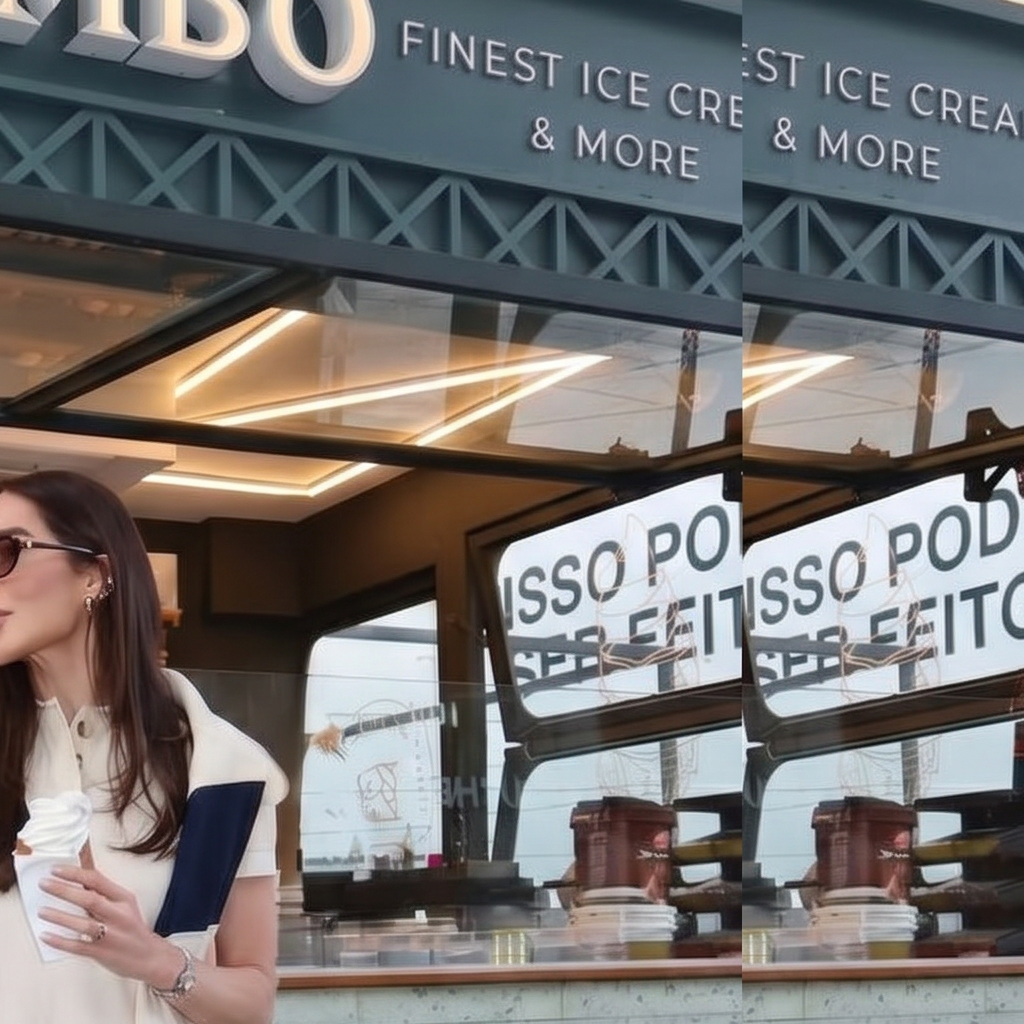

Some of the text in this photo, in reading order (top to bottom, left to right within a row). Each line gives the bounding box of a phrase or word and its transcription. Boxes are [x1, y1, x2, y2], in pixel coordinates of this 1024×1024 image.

[402, 20, 743, 128] FINEST ICE CRE
[824, 61, 892, 108] ICE
[910, 82, 1020, 136] CREA
[531, 116, 701, 180] & MORE
[773, 116, 942, 180] & MORE
[503, 540, 626, 631] ISSO
[746, 487, 1020, 631] ISSO POD
